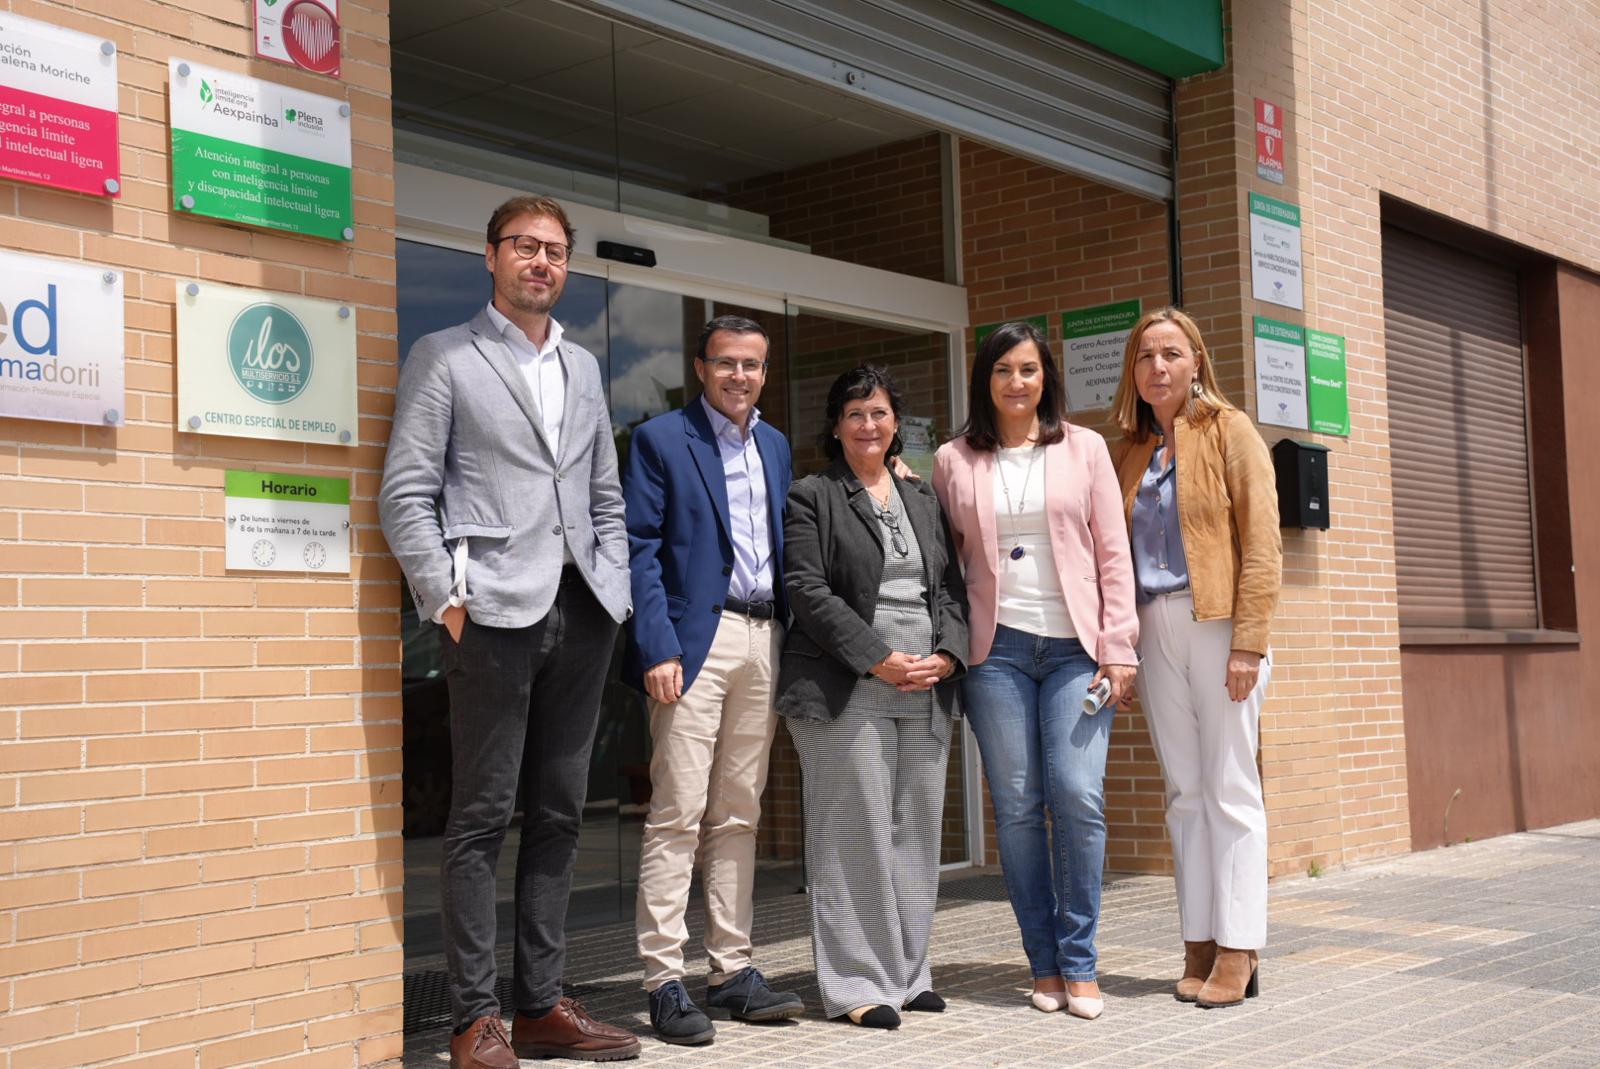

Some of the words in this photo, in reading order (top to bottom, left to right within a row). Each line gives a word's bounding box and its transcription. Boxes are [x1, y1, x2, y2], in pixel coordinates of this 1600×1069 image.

[40, 63, 91, 85] Moriche
[215, 88, 254, 102] inteligencia
[29, 109, 36, 119] a
[39, 112, 90, 131] personas
[213, 103, 278, 128] Aexpainba
[297, 111, 323, 126] Plena
[297, 121, 324, 132] inclusión
[41, 127, 76, 145] límite
[6, 137, 67, 162] intelectual
[71, 151, 104, 170] ligera
[1258, 154, 1283, 170] ALARMA
[195, 147, 240, 167] Atención
[243, 155, 279, 176] integral
[281, 168, 288, 177] a
[290, 169, 330, 185] personas
[211, 168, 231, 180] con
[233, 171, 289, 192] inteligencia
[291, 183, 319, 199] límite
[188, 180, 195, 191] y
[197, 181, 261, 203] discapacidad
[263, 193, 312, 213] intelectual
[314, 202, 340, 219] ligera
[0, 284, 58, 357] d
[1067, 320, 1084, 329] JUNTA
[1093, 312, 1135, 324] EXTREMADURA
[1070, 342, 1094, 351] Centro
[1082, 352, 1110, 362] Servicio
[0, 358, 100, 388] madorii
[241, 368, 289, 382] MULTISERVICIO
[1069, 365, 1093, 375] Centro
[204, 412, 242, 425] CENTRO
[245, 415, 286, 430] ESPECIAL
[288, 419, 300, 431] DE
[302, 421, 337, 433] EMPLEO
[261, 480, 317, 496] Horario
[240, 514, 250, 522] De
[251, 515, 270, 523] lunes
[277, 517, 300, 525] viernes
[246, 525, 255, 533] de
[256, 525, 263, 533] la
[264, 526, 290, 535] mañana
[302, 528, 311, 536] de
[312, 528, 318, 536] la
[319, 529, 336, 537] tarde
